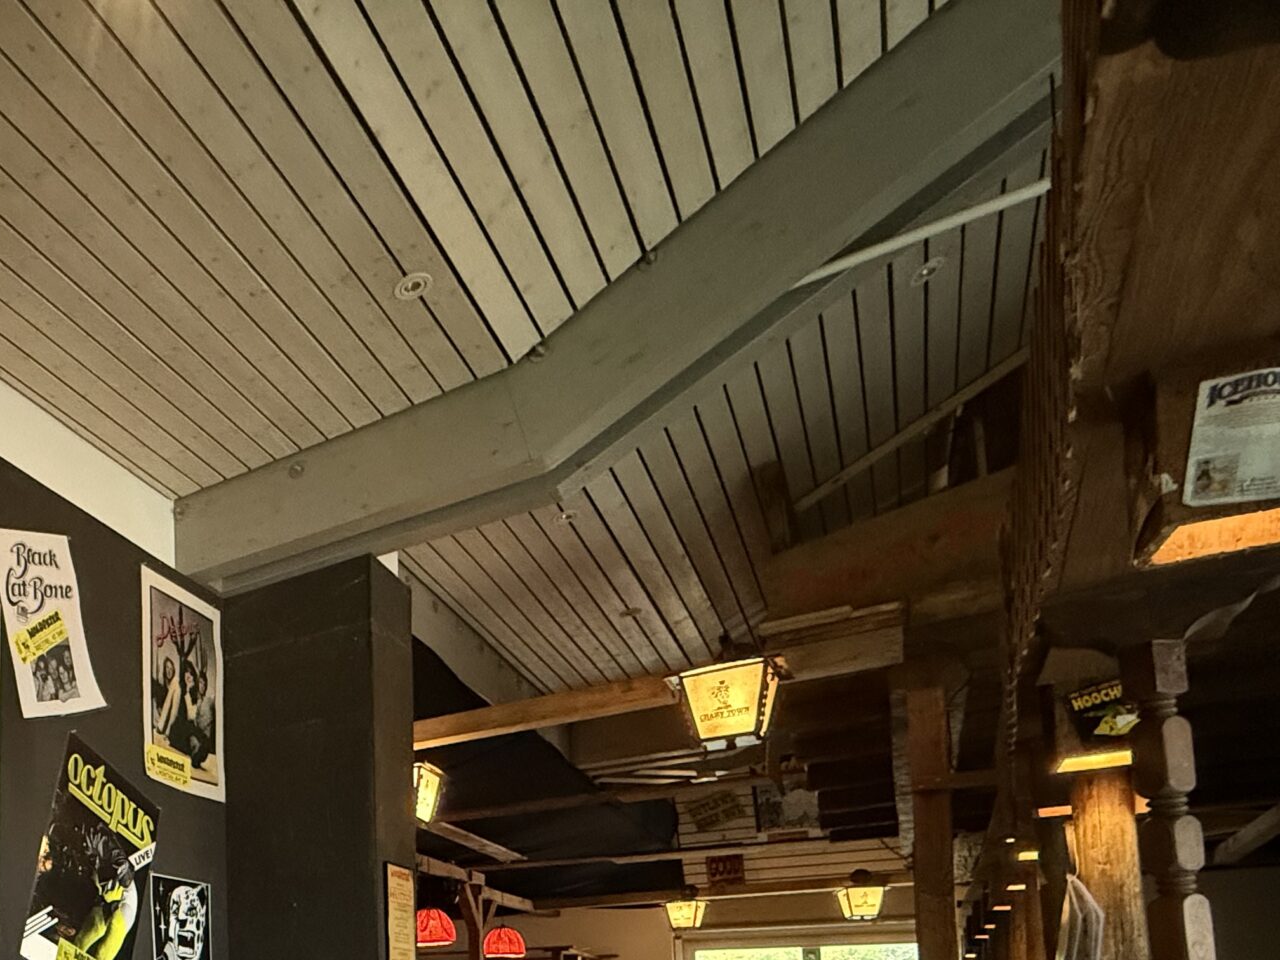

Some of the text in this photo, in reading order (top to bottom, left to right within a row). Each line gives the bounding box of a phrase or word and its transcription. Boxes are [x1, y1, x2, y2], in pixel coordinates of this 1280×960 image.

[10, 543, 60, 579] Black
[6, 567, 72, 614] Cat Bone
